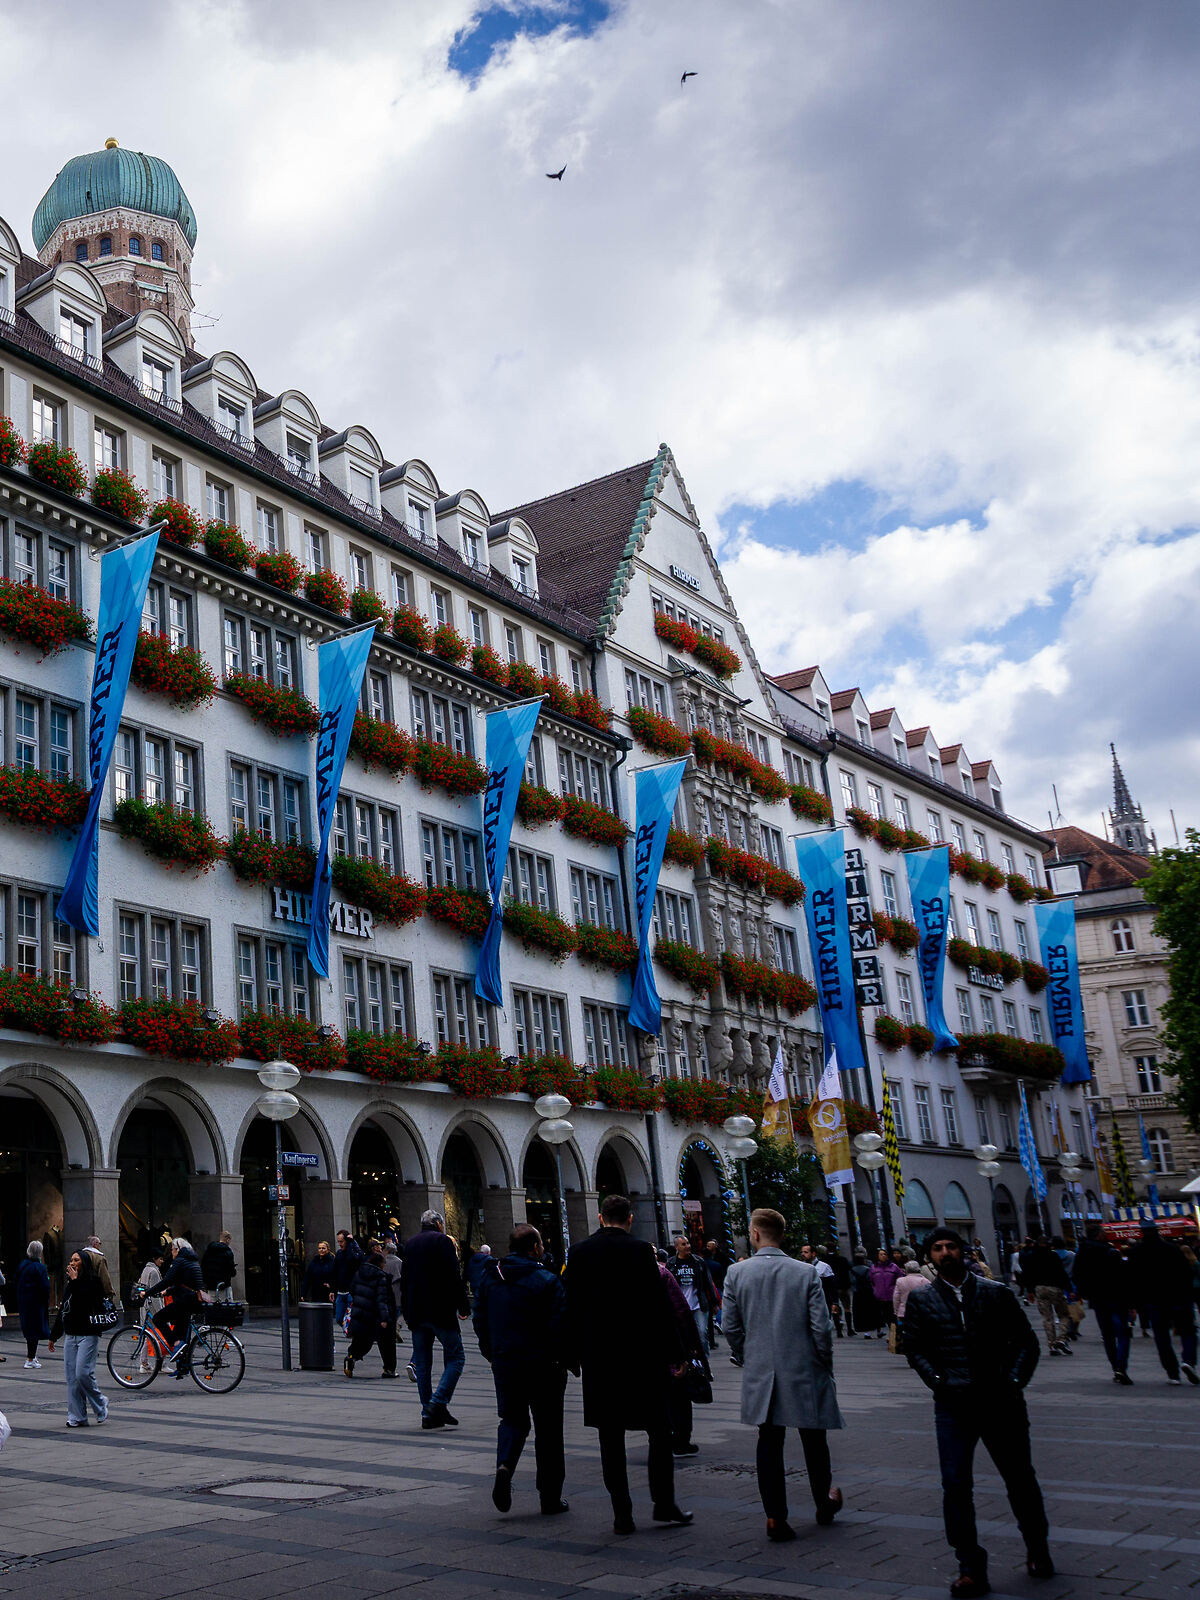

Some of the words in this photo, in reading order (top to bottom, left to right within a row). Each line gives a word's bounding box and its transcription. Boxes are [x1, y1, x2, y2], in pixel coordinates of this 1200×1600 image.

[90, 622, 124, 795] RMER
[484, 766, 509, 893] RMER
[273, 886, 375, 939] HIMER
[812, 887, 843, 1012] HIRMER
[844, 851, 880, 1004] HIRMER
